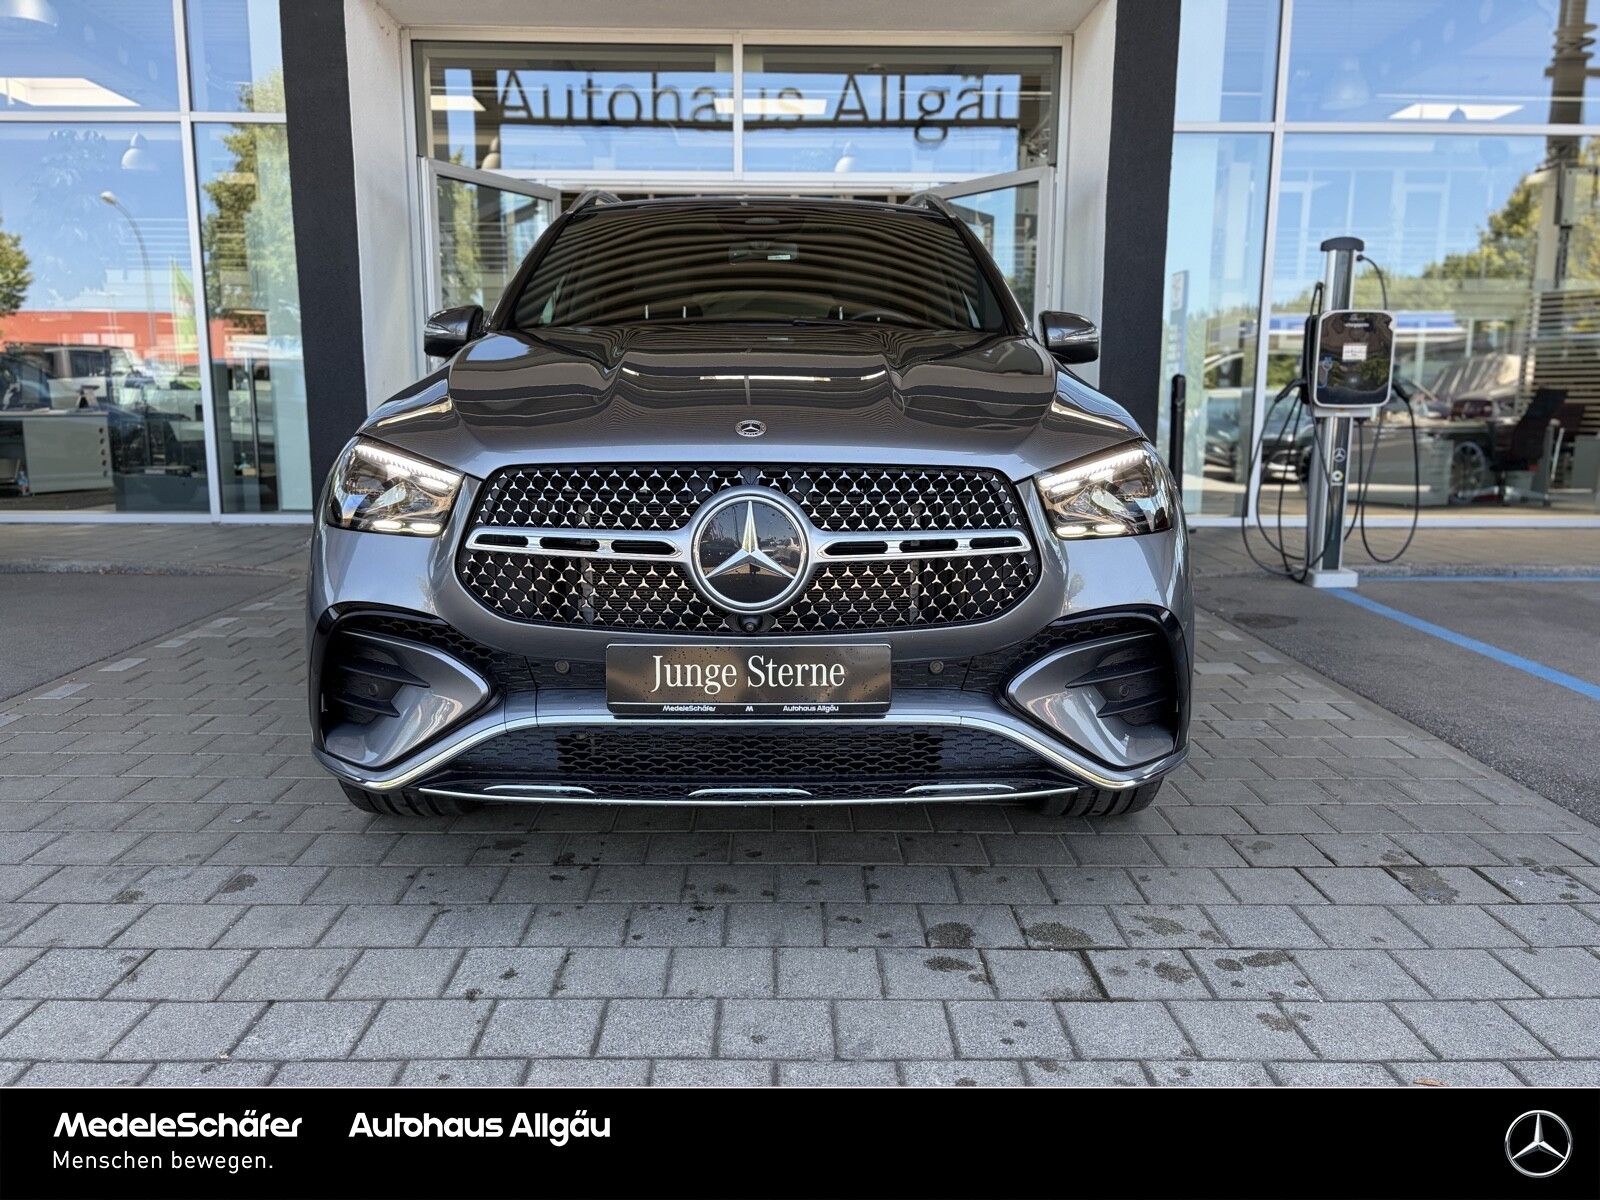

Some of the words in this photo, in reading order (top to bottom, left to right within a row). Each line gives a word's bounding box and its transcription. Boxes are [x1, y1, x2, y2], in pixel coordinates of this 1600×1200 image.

[651, 655, 737, 695] Junge
[747, 655, 845, 688] Sterne
[782, 704, 816, 713] Autohaus
[816, 704, 839, 714] Allgäu
